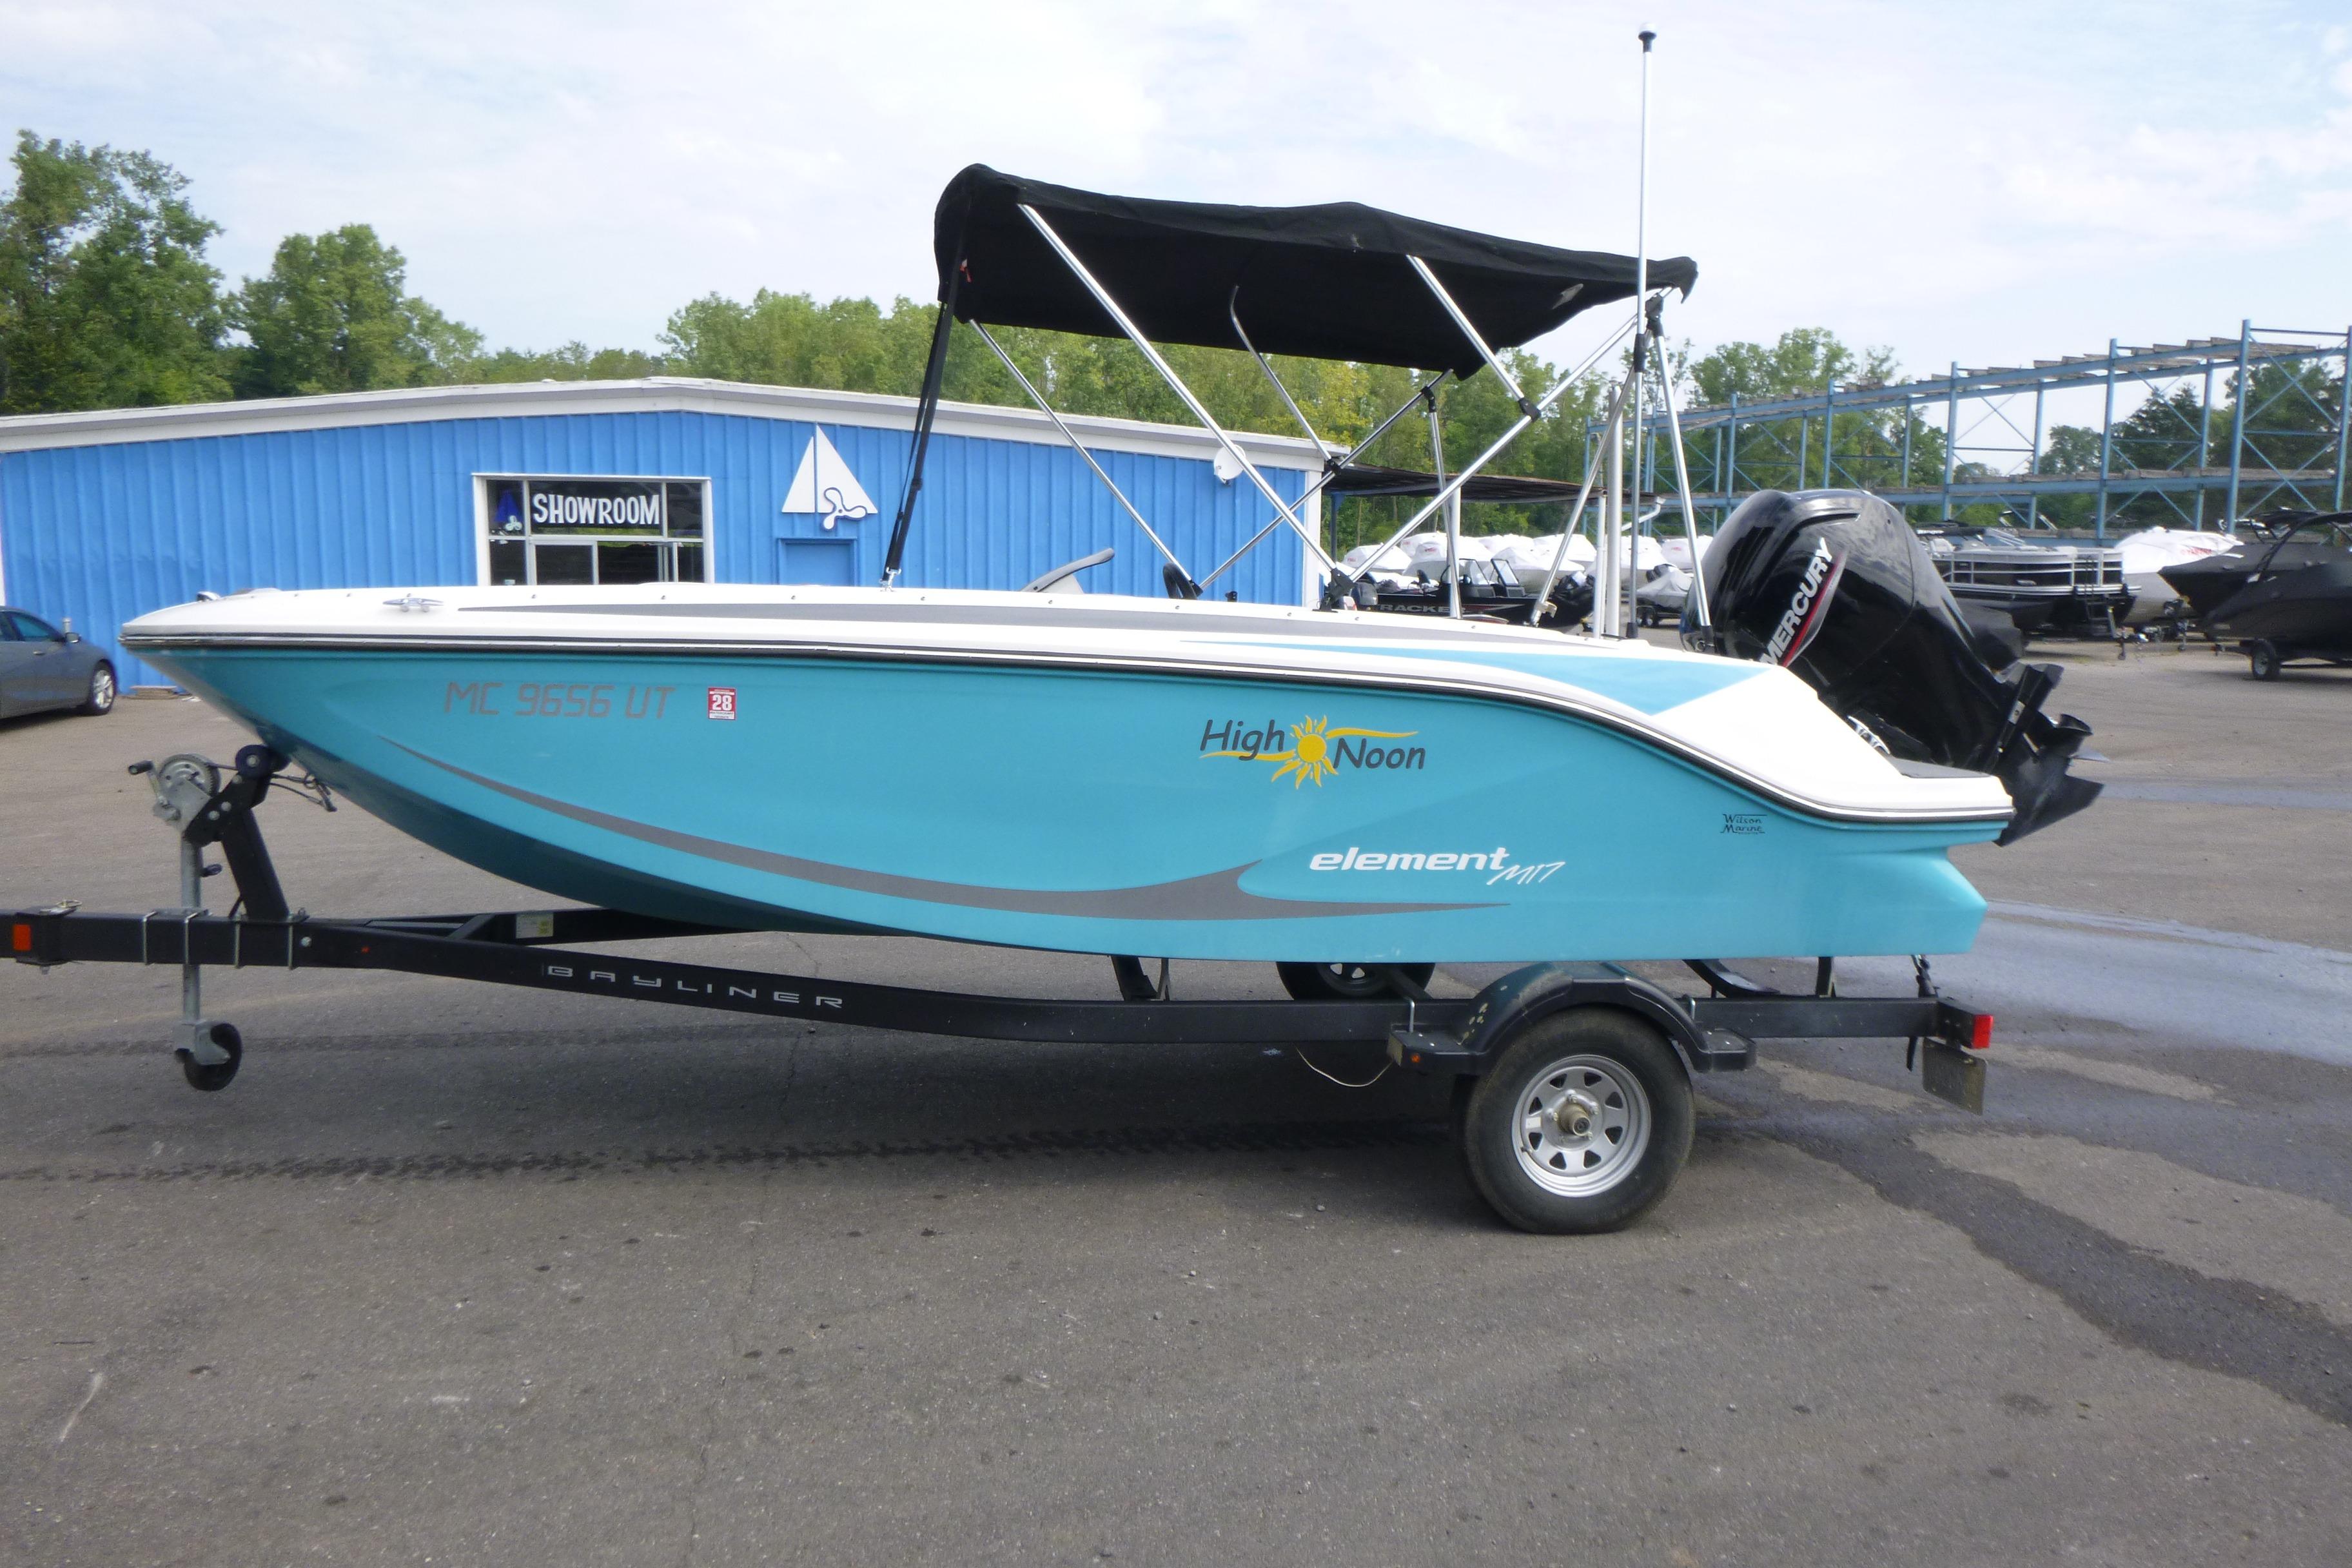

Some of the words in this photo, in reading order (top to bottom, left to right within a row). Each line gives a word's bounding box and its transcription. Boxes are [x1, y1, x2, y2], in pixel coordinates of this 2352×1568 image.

[532, 493, 660, 525] SHOWROOM
[1378, 603, 1466, 614] RACKE
[1759, 537, 1833, 665] MERCURY
[445, 681, 504, 715] MC
[514, 683, 615, 718] 9656
[624, 685, 676, 720] UT
[712, 694, 732, 711] 28
[1200, 719, 1285, 761] High
[1333, 738, 1426, 769] Noon
[1722, 814, 1762, 824] Wilson
[1309, 847, 1510, 870] element
[1486, 861, 1566, 886] M17
[547, 965, 843, 1008] BAYLINER
